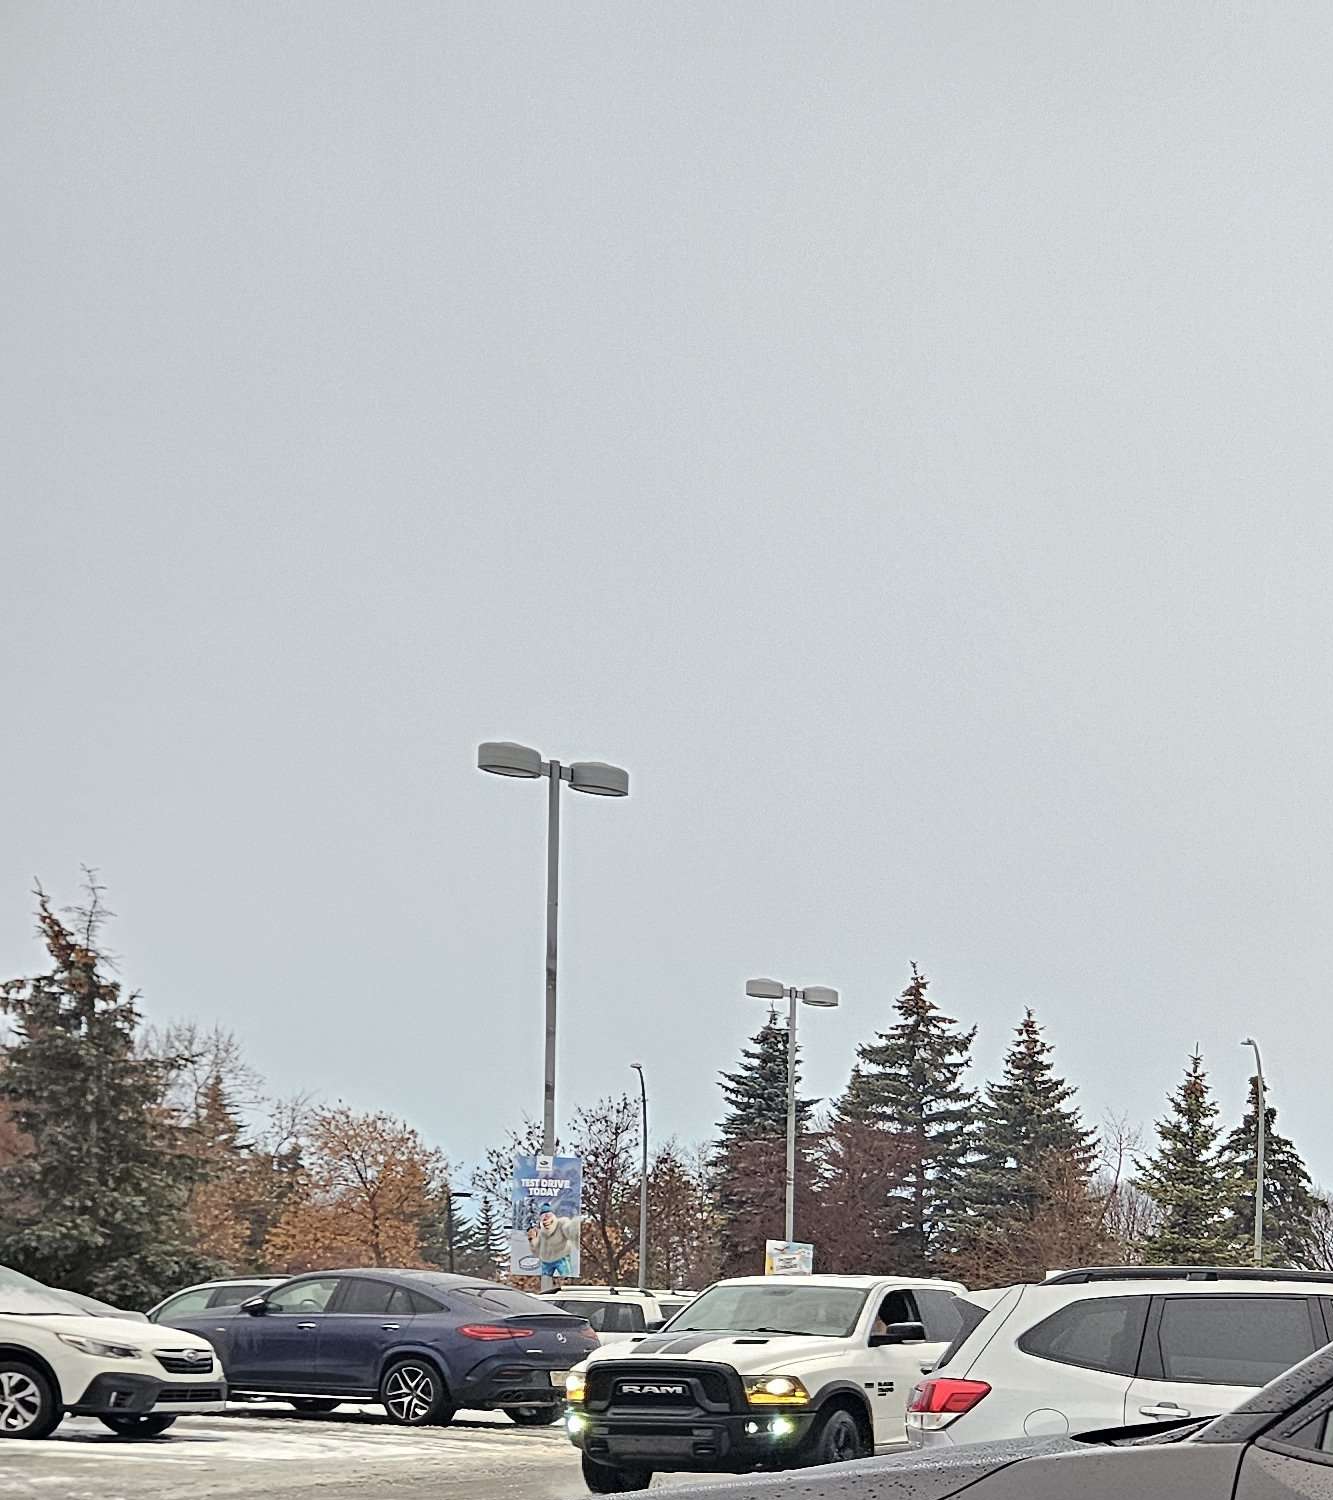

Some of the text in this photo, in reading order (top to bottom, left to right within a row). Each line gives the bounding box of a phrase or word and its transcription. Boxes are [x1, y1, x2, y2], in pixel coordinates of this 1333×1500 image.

[521, 1179, 570, 1189] TEST DRIVE
[528, 1188, 560, 1197] TODAY
[622, 1386, 683, 1394] RAM
